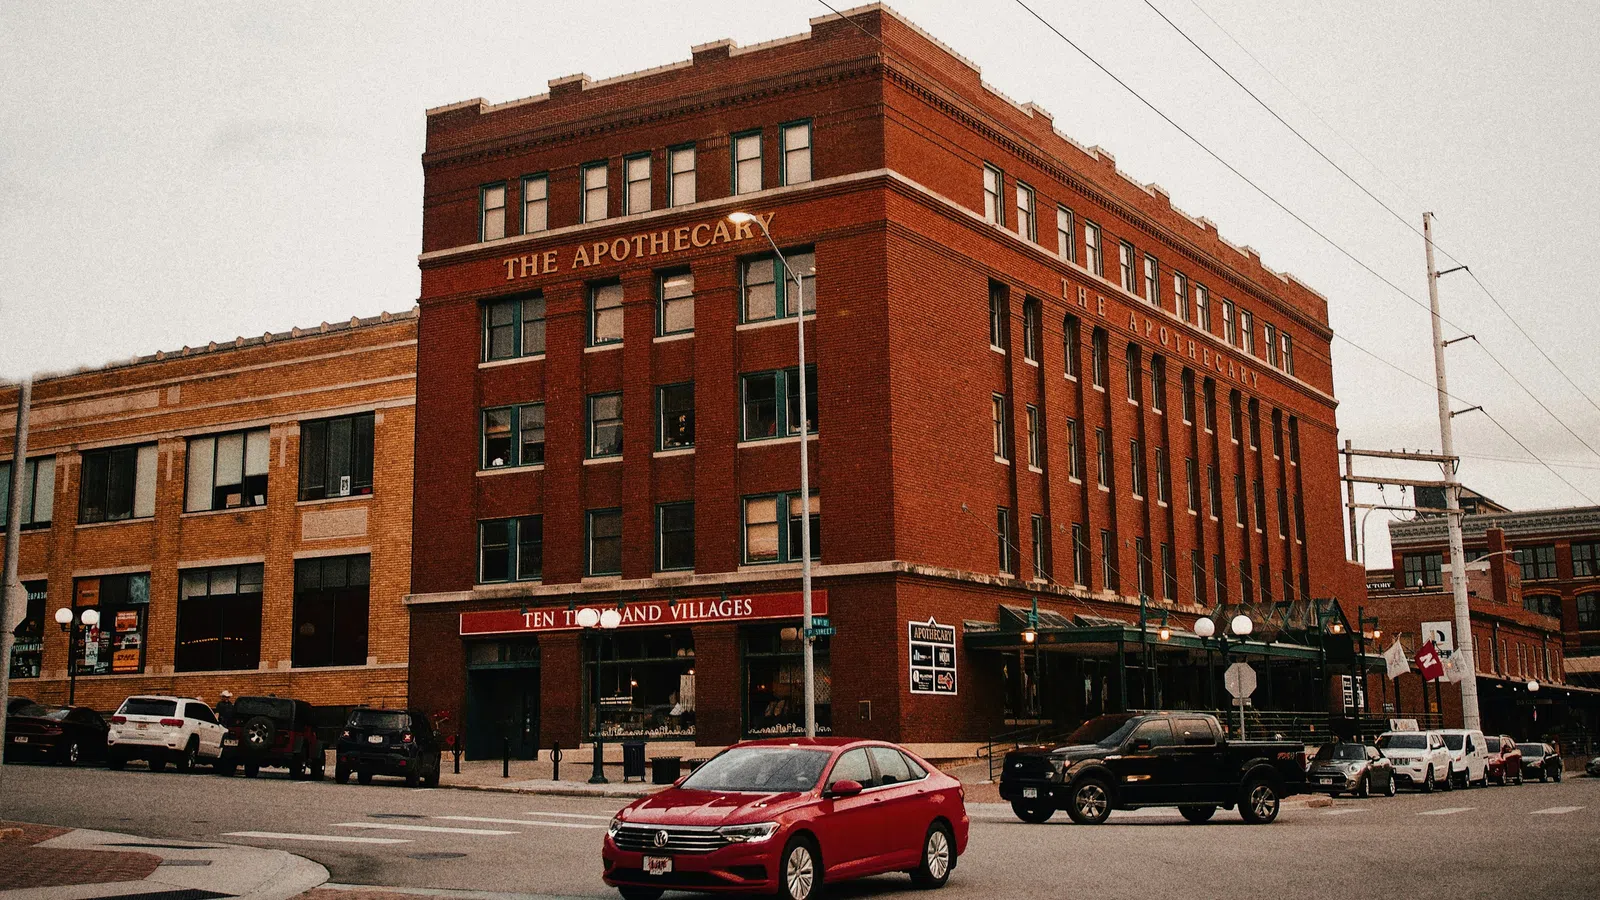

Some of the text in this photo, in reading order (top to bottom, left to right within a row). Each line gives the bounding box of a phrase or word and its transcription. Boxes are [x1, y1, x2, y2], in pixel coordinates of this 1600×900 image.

[503, 212, 775, 280] THE APOTHECARY
[1061, 278, 1258, 388] THE APOTHECARY
[522, 611, 554, 628] TEN
[670, 598, 752, 619] VILLAGES
[914, 627, 952, 642] APOTHECARY
[1420, 653, 1437, 669] N
